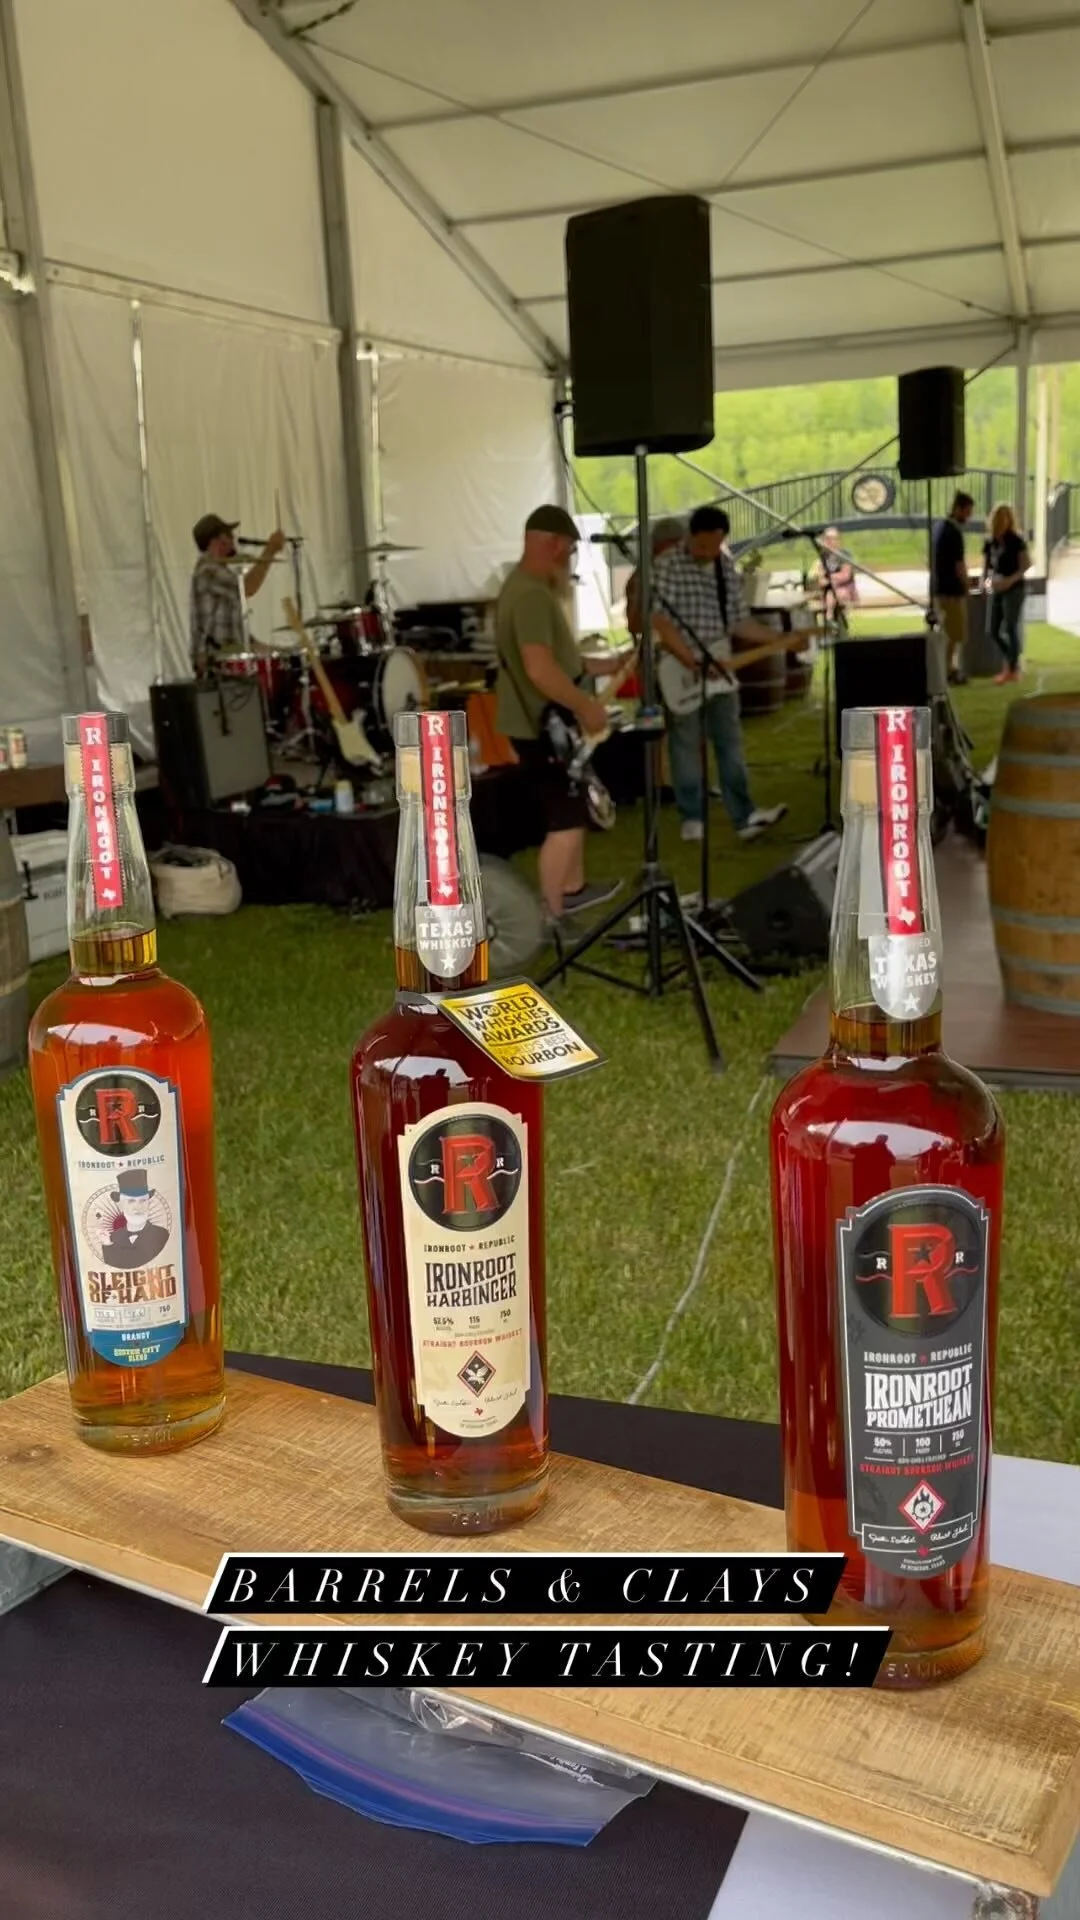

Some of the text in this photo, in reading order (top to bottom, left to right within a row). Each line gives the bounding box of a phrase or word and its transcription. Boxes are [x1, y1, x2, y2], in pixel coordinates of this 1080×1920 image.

[85, 727, 102, 745] R
[427, 715, 444, 737] R
[91, 759, 114, 880] IRONROOT
[890, 744, 911, 897] IRONROOT
[419, 920, 473, 938] TEXAS
[874, 951, 937, 975] TXAS
[458, 996, 538, 1021] WORLD
[470, 1007, 550, 1031] WHISKIES
[481, 1017, 560, 1043] AWARDS
[501, 1041, 582, 1066] BOURBON
[95, 1088, 144, 1145] R
[439, 1134, 501, 1214] R
[424, 1235, 515, 1253] IRONROOT REPUBLIC
[87, 1263, 175, 1291] SLEIGHT
[425, 1252, 516, 1293] IRONROOT
[876, 1223, 964, 1318] R R R
[119, 1277, 176, 1304] HAND
[426, 1270, 517, 1307] HARBINGER
[864, 1343, 973, 1364] IRONROOT REPUBLIC
[864, 1363, 973, 1410] IRONROOT
[866, 1383, 973, 1429] PROMETHEAN
[915, 1437, 931, 1448] 100
